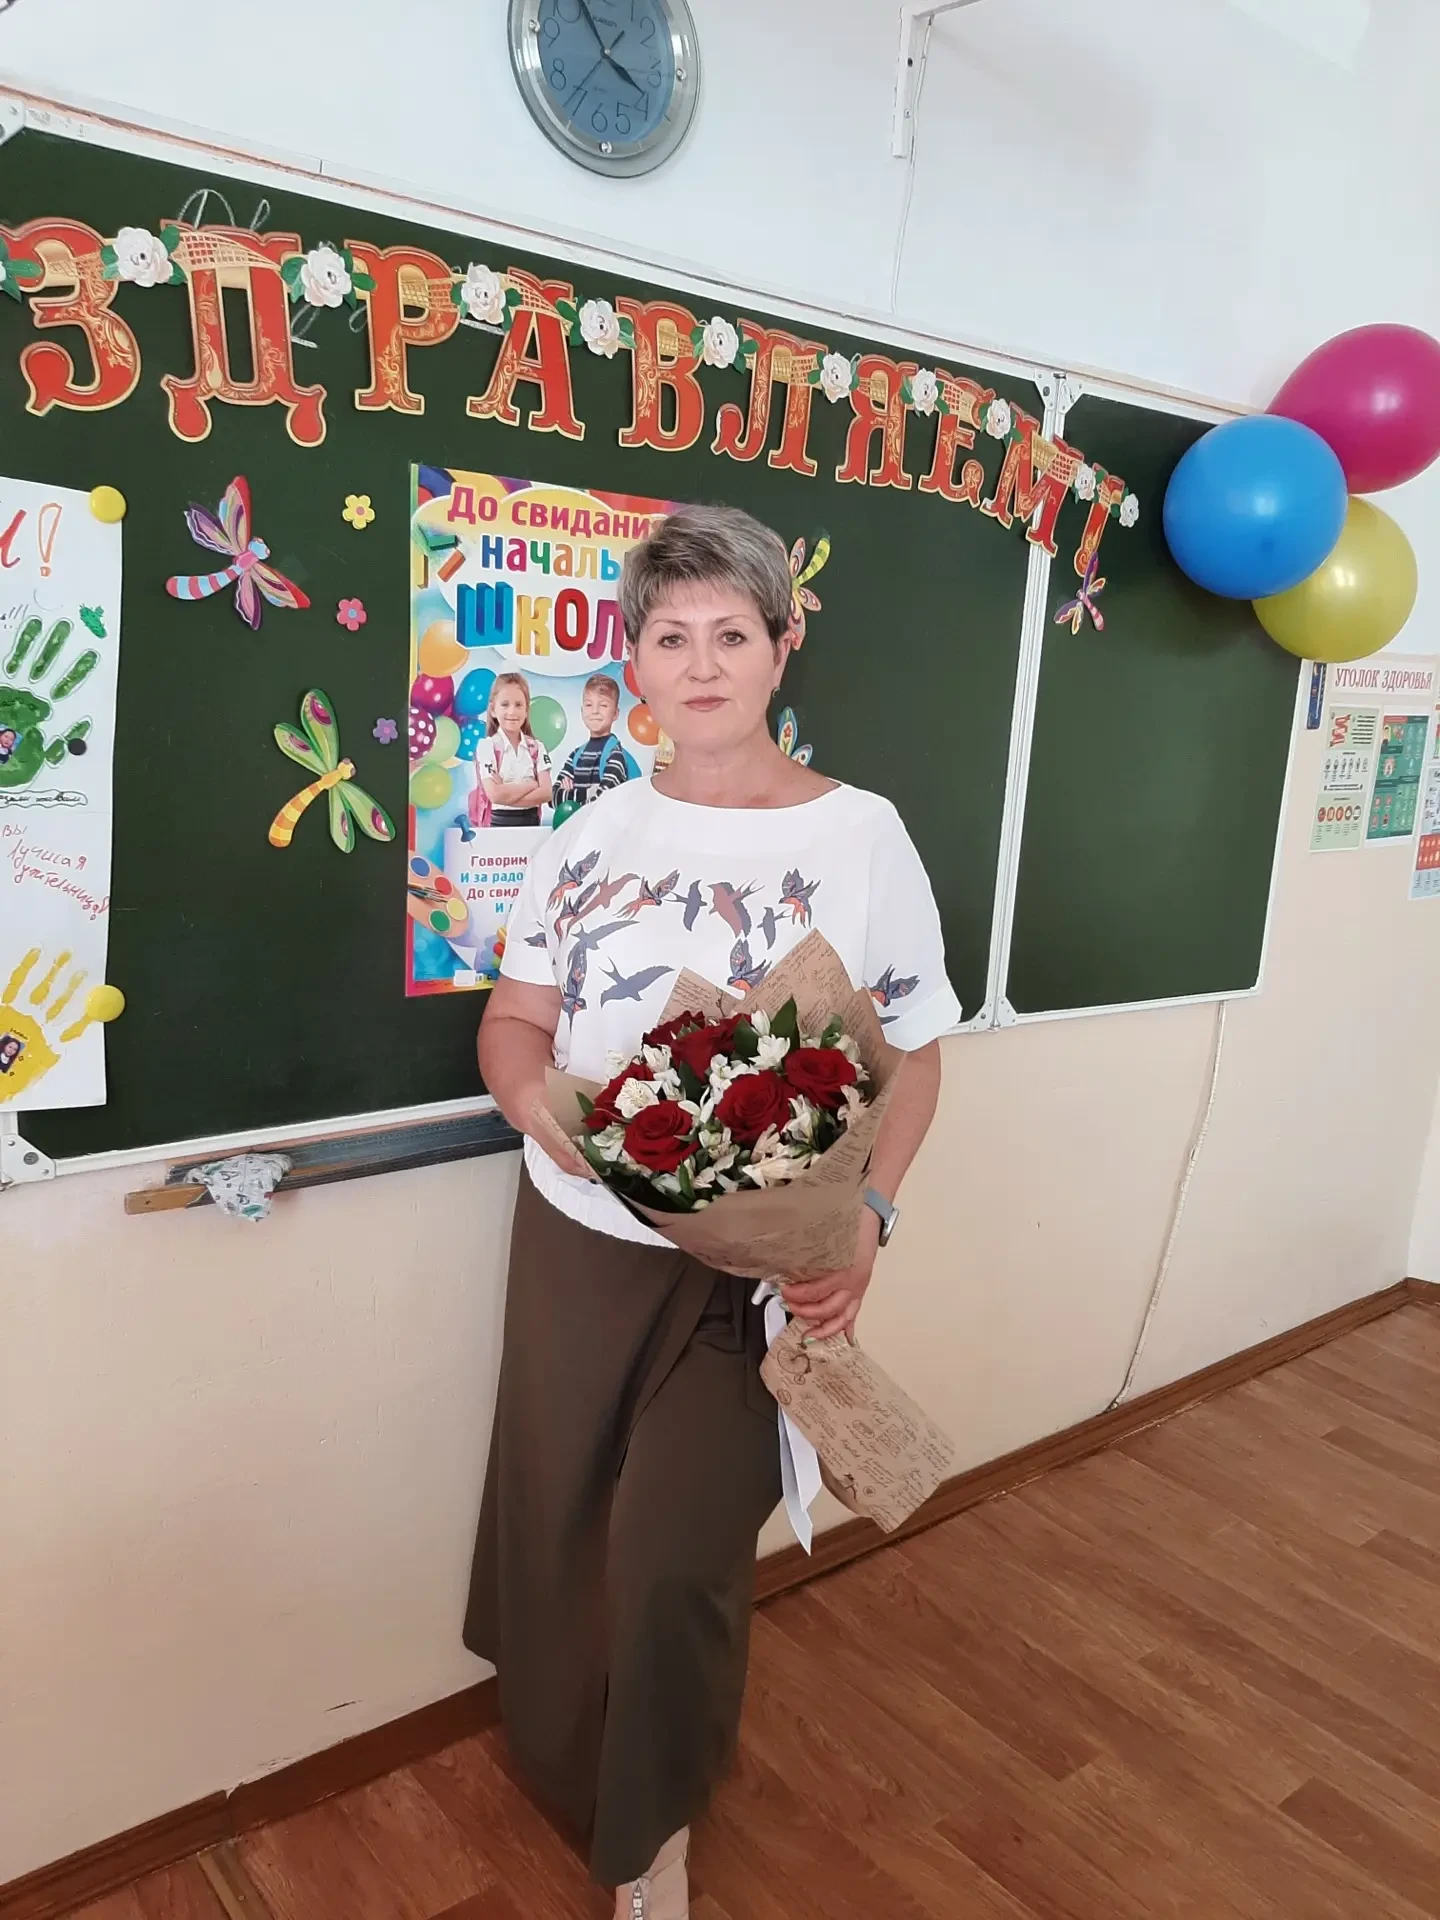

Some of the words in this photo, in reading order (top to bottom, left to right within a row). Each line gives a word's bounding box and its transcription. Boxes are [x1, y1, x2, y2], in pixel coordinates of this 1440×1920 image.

[543, 17, 560, 48] 9
[640, 16, 656, 49] 2
[550, 58, 567, 91] 8
[572, 84, 588, 117] 7
[632, 92, 650, 121] 4
[591, 102, 608, 133] 6
[615, 101, 632, 135] 5
[447, 486, 499, 525] До
[1335, 668, 1380, 689] УГОЛОК
[1381, 669, 1433, 693] ЗДОРОВЬЯ
[471, 856, 528, 868] Говорим
[461, 873, 469, 883] И
[474, 873, 488, 883] за
[467, 888, 485, 900] До
[495, 902, 504, 913] И
